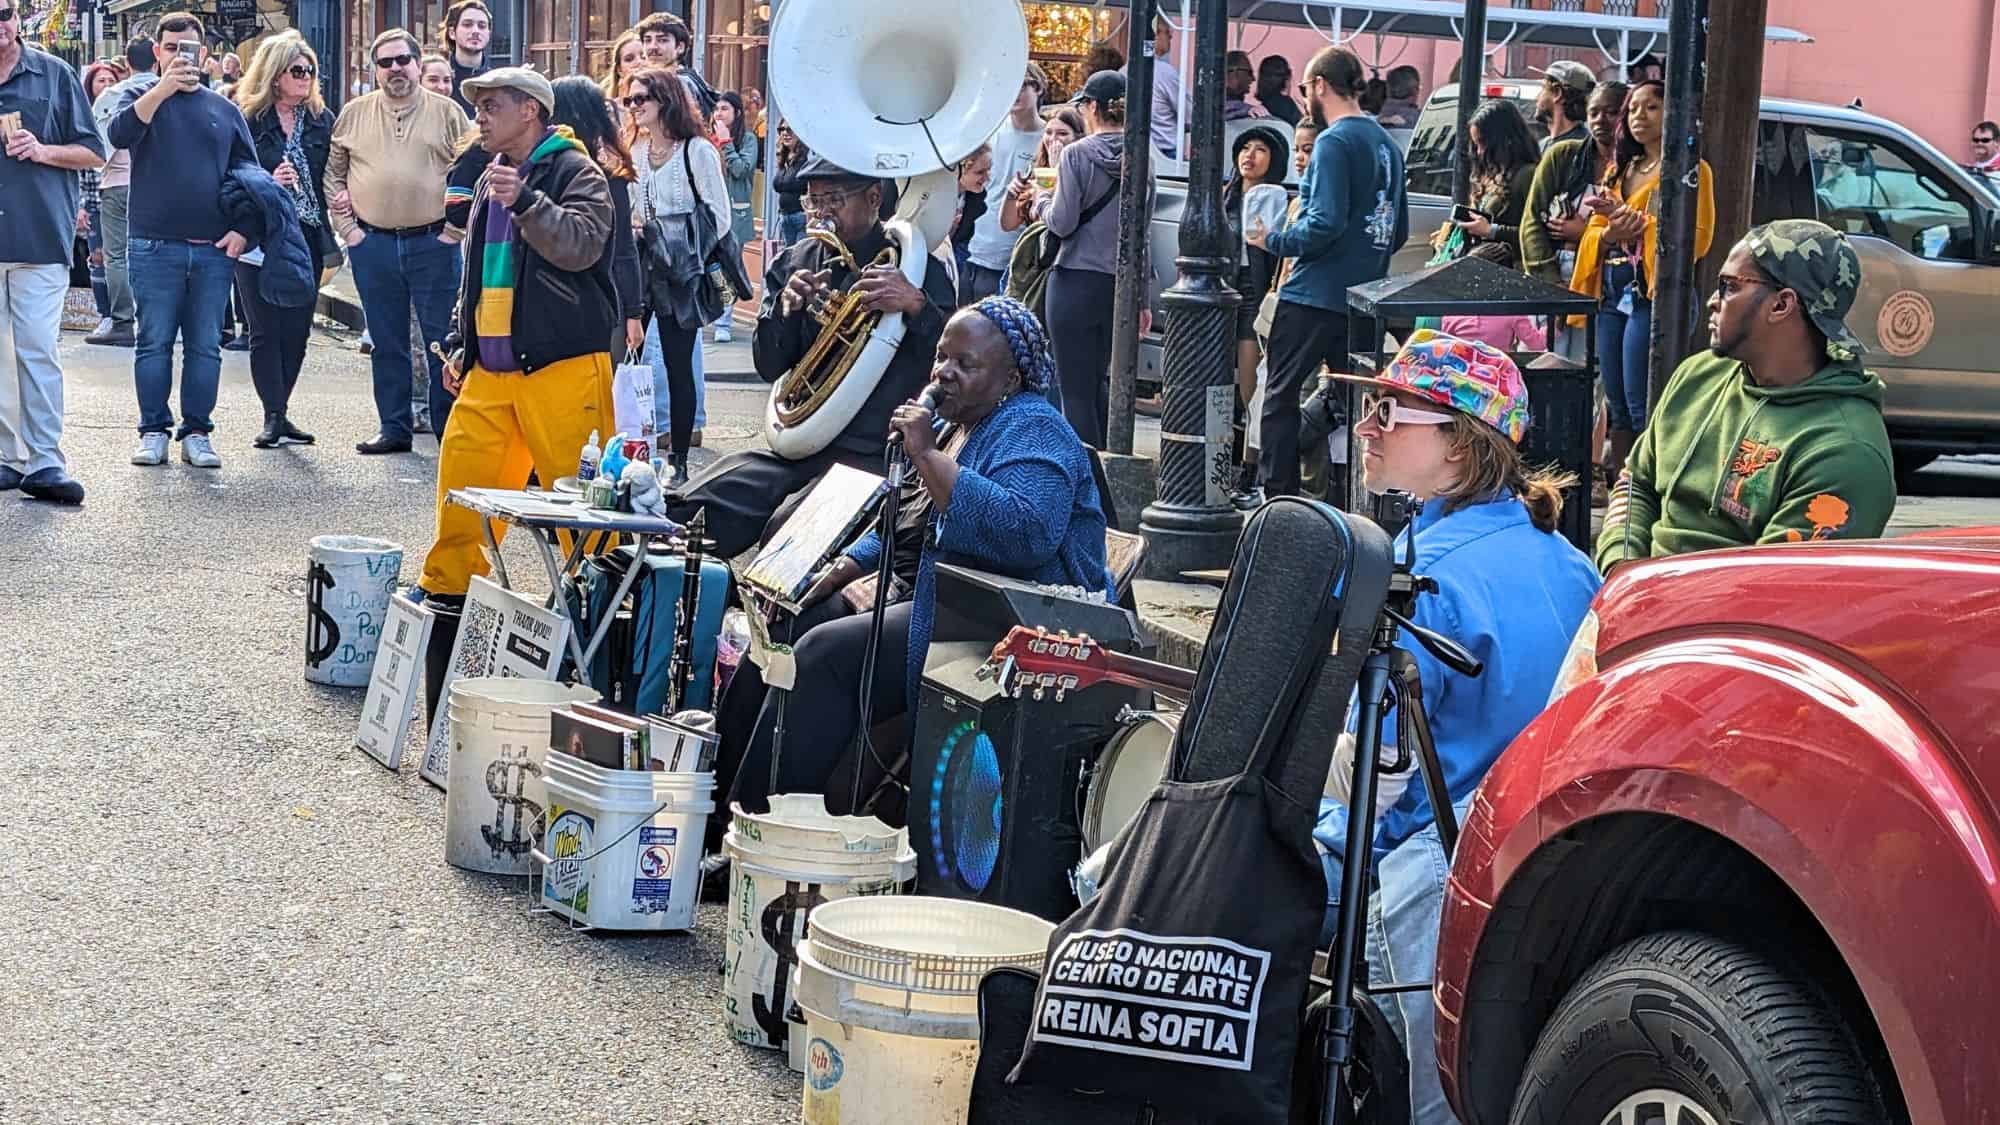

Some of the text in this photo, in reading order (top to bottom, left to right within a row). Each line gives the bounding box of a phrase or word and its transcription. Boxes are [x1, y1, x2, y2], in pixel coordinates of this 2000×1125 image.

[486, 611, 505, 678] enmo
[1055, 961, 1251, 1007] CENTRO DE ARTE
[1063, 940, 1252, 982] MUSEO NACIONAL
[1042, 998, 1239, 1055] REINA SOFIA
